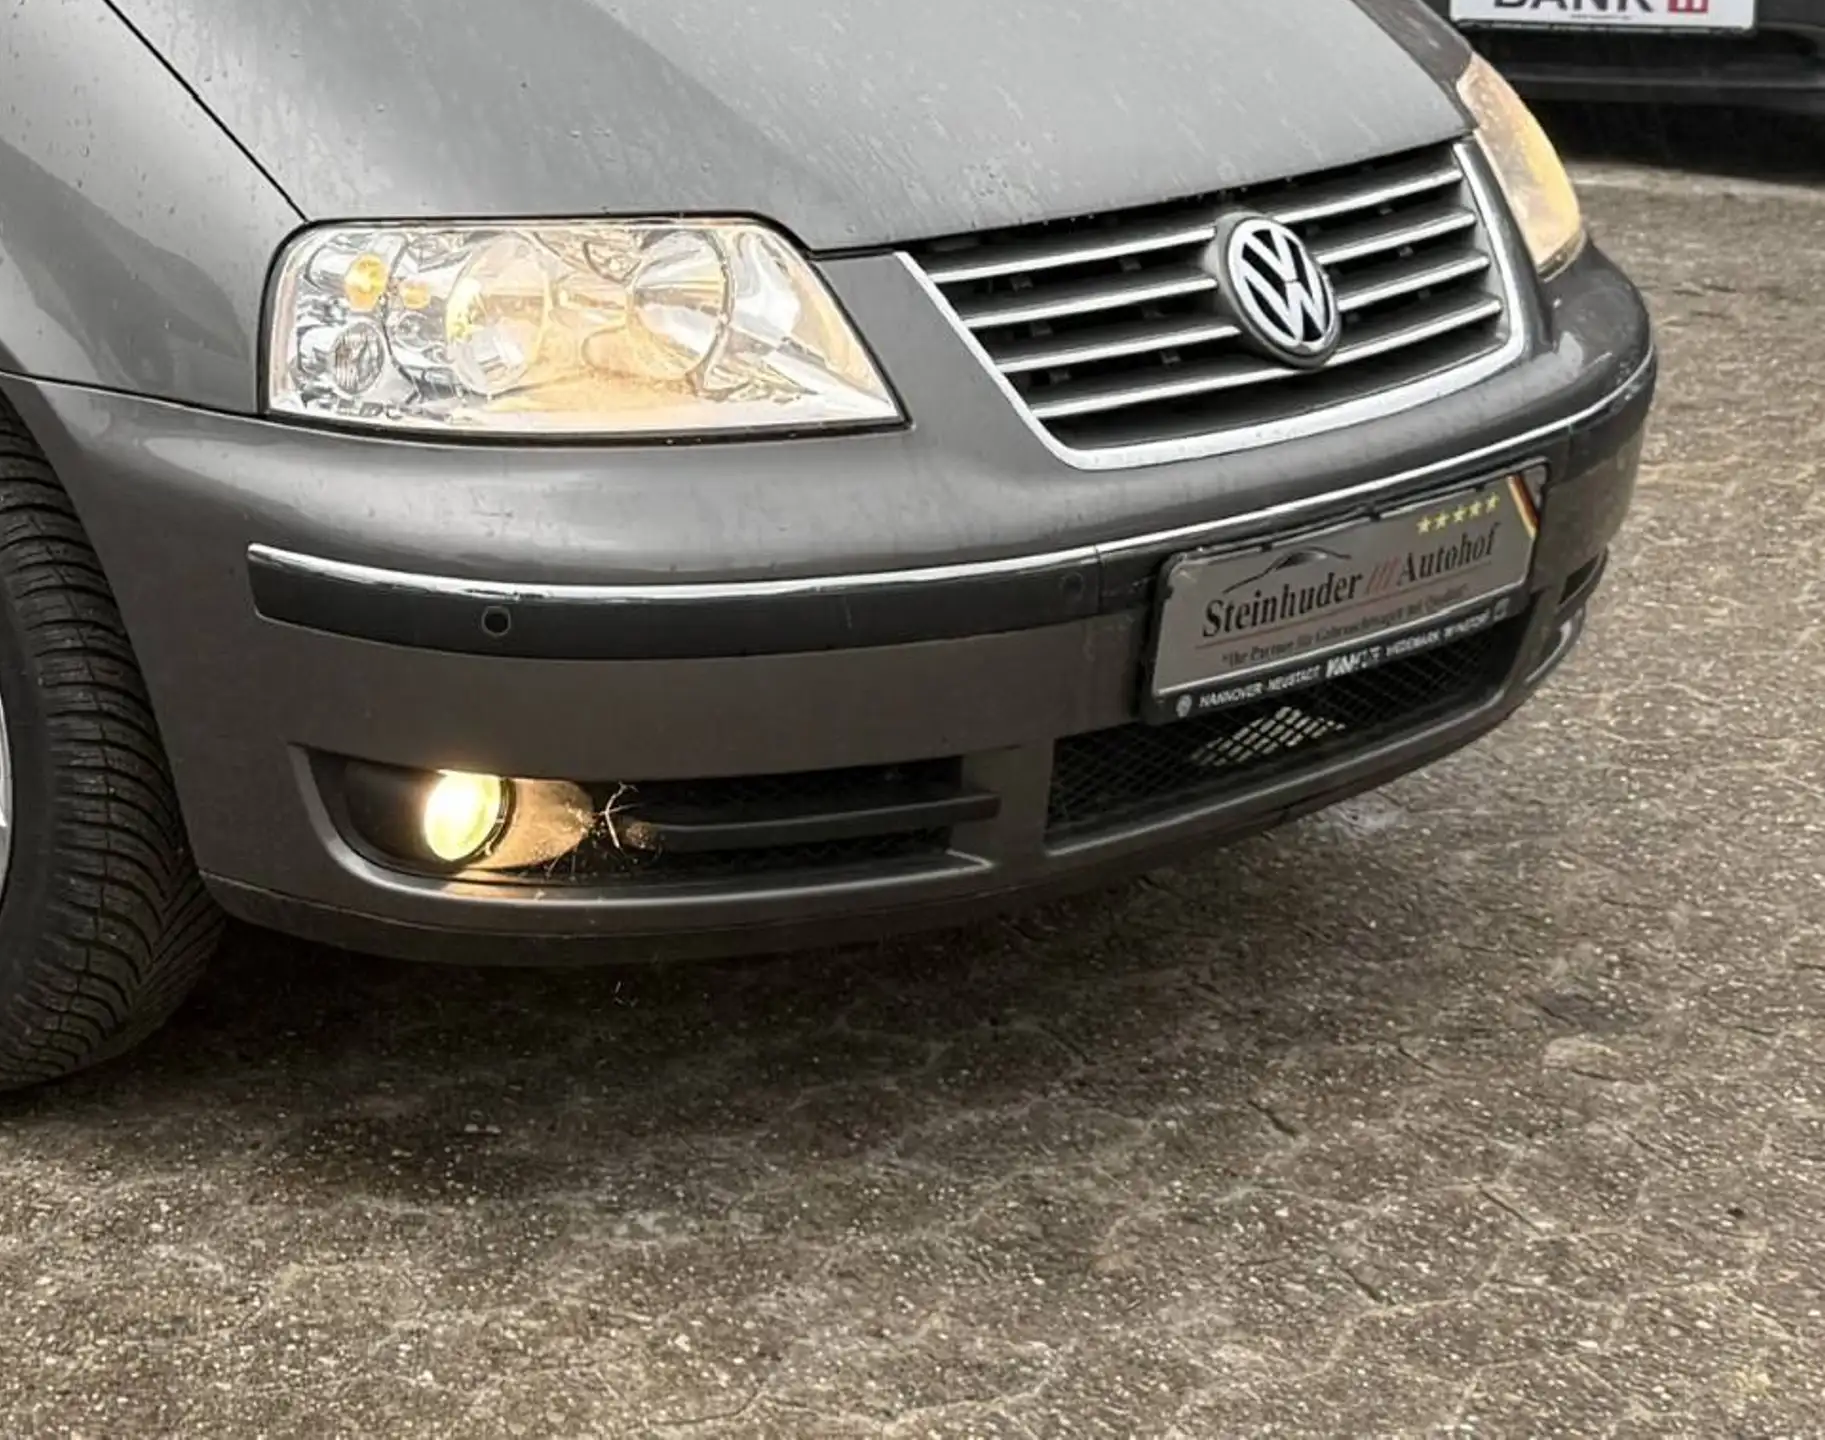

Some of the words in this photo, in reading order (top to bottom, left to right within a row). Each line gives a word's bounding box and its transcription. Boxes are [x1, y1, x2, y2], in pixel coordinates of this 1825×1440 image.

[1230, 220, 1333, 352] VW
[1203, 572, 1364, 638] Steinhuder
[1396, 522, 1501, 587] Autohof
